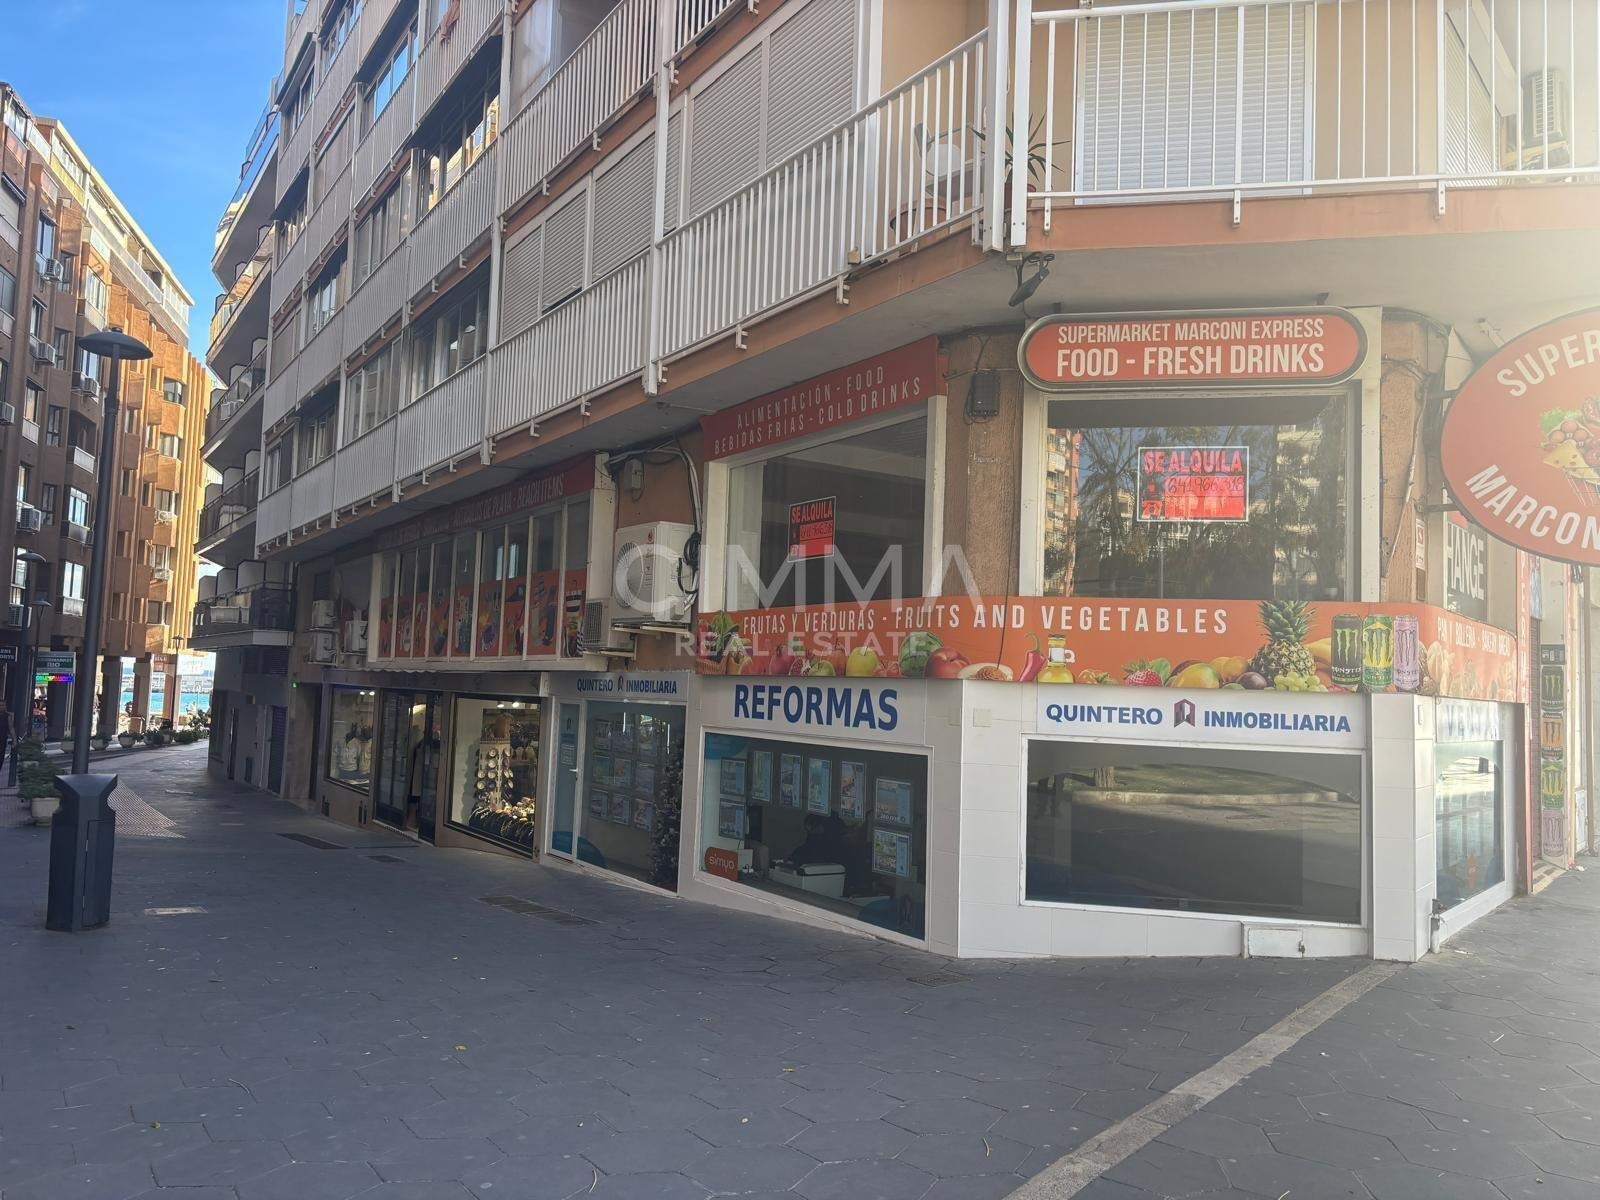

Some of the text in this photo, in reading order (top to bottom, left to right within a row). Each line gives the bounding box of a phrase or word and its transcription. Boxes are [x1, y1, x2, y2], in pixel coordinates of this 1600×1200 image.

[1057, 318, 1324, 344] SUPERMARKET MARCONI EXPRESS
[1056, 348, 1119, 377] FOOD
[1143, 345, 1221, 376] FRESH
[1229, 343, 1325, 374] DRINKS
[736, 383, 831, 430] ALIMENTACIÓN
[846, 366, 884, 395] FOOD
[713, 427, 763, 455] BEBIDAS
[768, 414, 805, 441] FRIAS
[818, 398, 854, 425] COLD
[860, 376, 921, 413] DRINKS
[1144, 449, 1243, 475] SE ALQUILA
[791, 500, 833, 524] SE ALQUILA
[743, 604, 1228, 636] FRUTAS Y VERDURAS FRUITS AND VEGETABLES
[576, 678, 677, 694] QUINTERO INMOBILIARIA
[733, 684, 898, 731] REFORMAS
[1045, 703, 1352, 733] QUINTERO INMOBILIARIA
[709, 852, 736, 873] simyo
